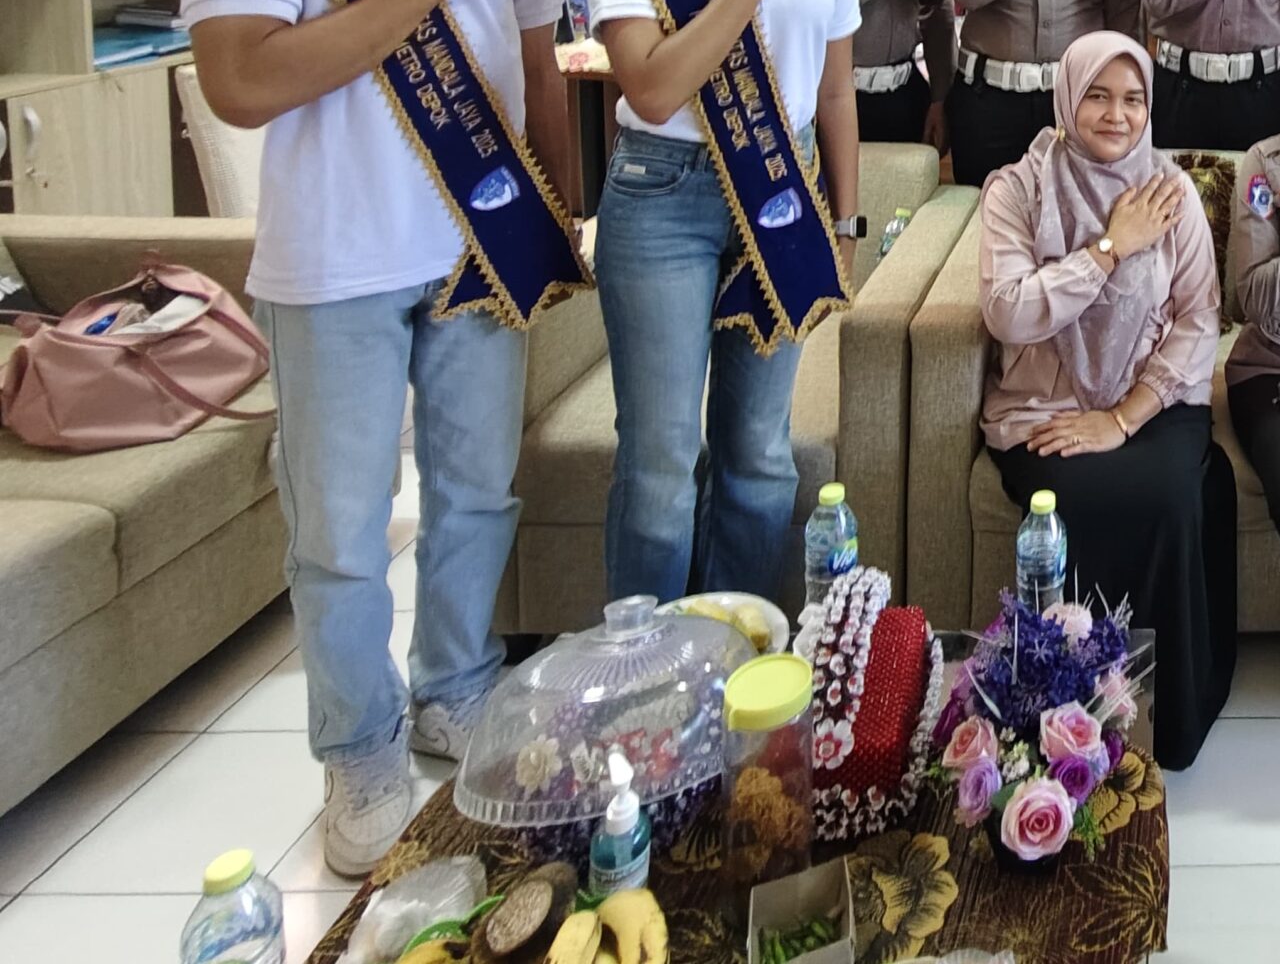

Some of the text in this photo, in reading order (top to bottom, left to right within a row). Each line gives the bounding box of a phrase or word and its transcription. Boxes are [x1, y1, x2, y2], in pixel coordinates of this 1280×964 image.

[416, 83, 452, 131] DEPOK
[422, 36, 467, 99] MANDALA
[454, 99, 481, 132] JAYA
[471, 128, 499, 159] 2025
[709, 68, 734, 107] ETRO
